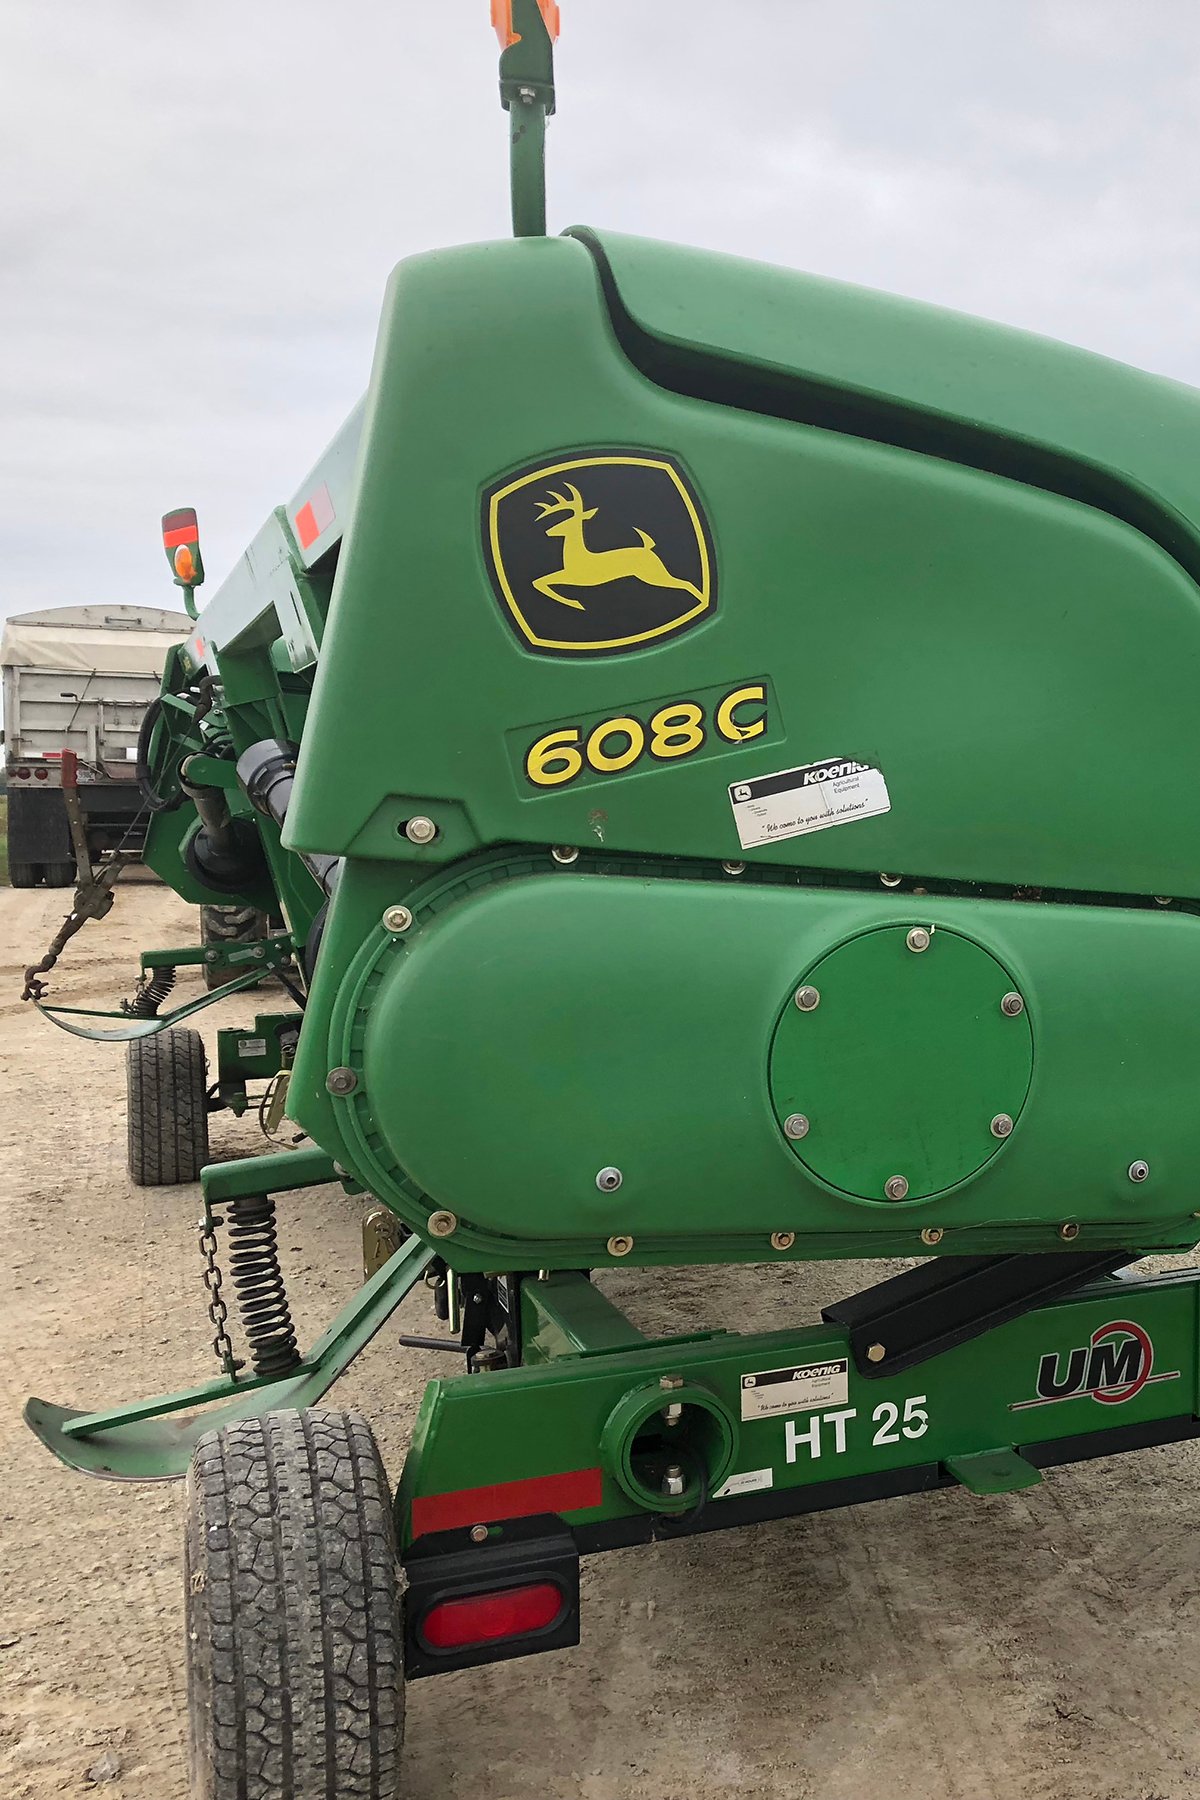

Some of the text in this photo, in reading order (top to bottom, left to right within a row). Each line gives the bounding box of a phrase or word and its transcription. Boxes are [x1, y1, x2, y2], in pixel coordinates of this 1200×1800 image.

[1037, 1338, 1146, 1399] UM
[785, 1395, 929, 1464] HT 25
